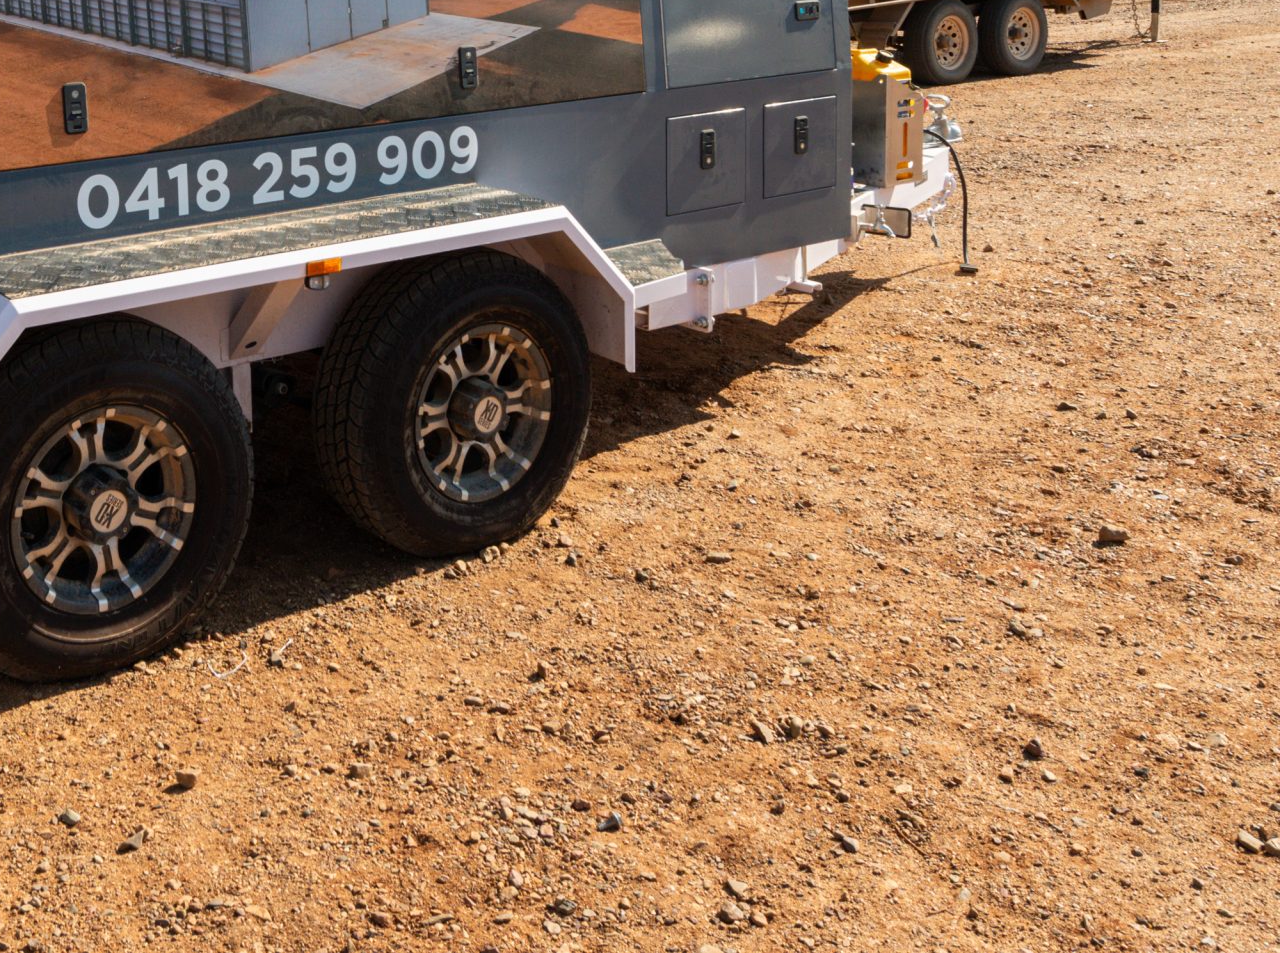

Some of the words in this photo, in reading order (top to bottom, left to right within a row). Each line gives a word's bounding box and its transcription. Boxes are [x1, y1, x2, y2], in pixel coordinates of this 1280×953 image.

[77, 159, 231, 230] 0418
[252, 142, 357, 205] 259
[376, 125, 479, 185] 909
